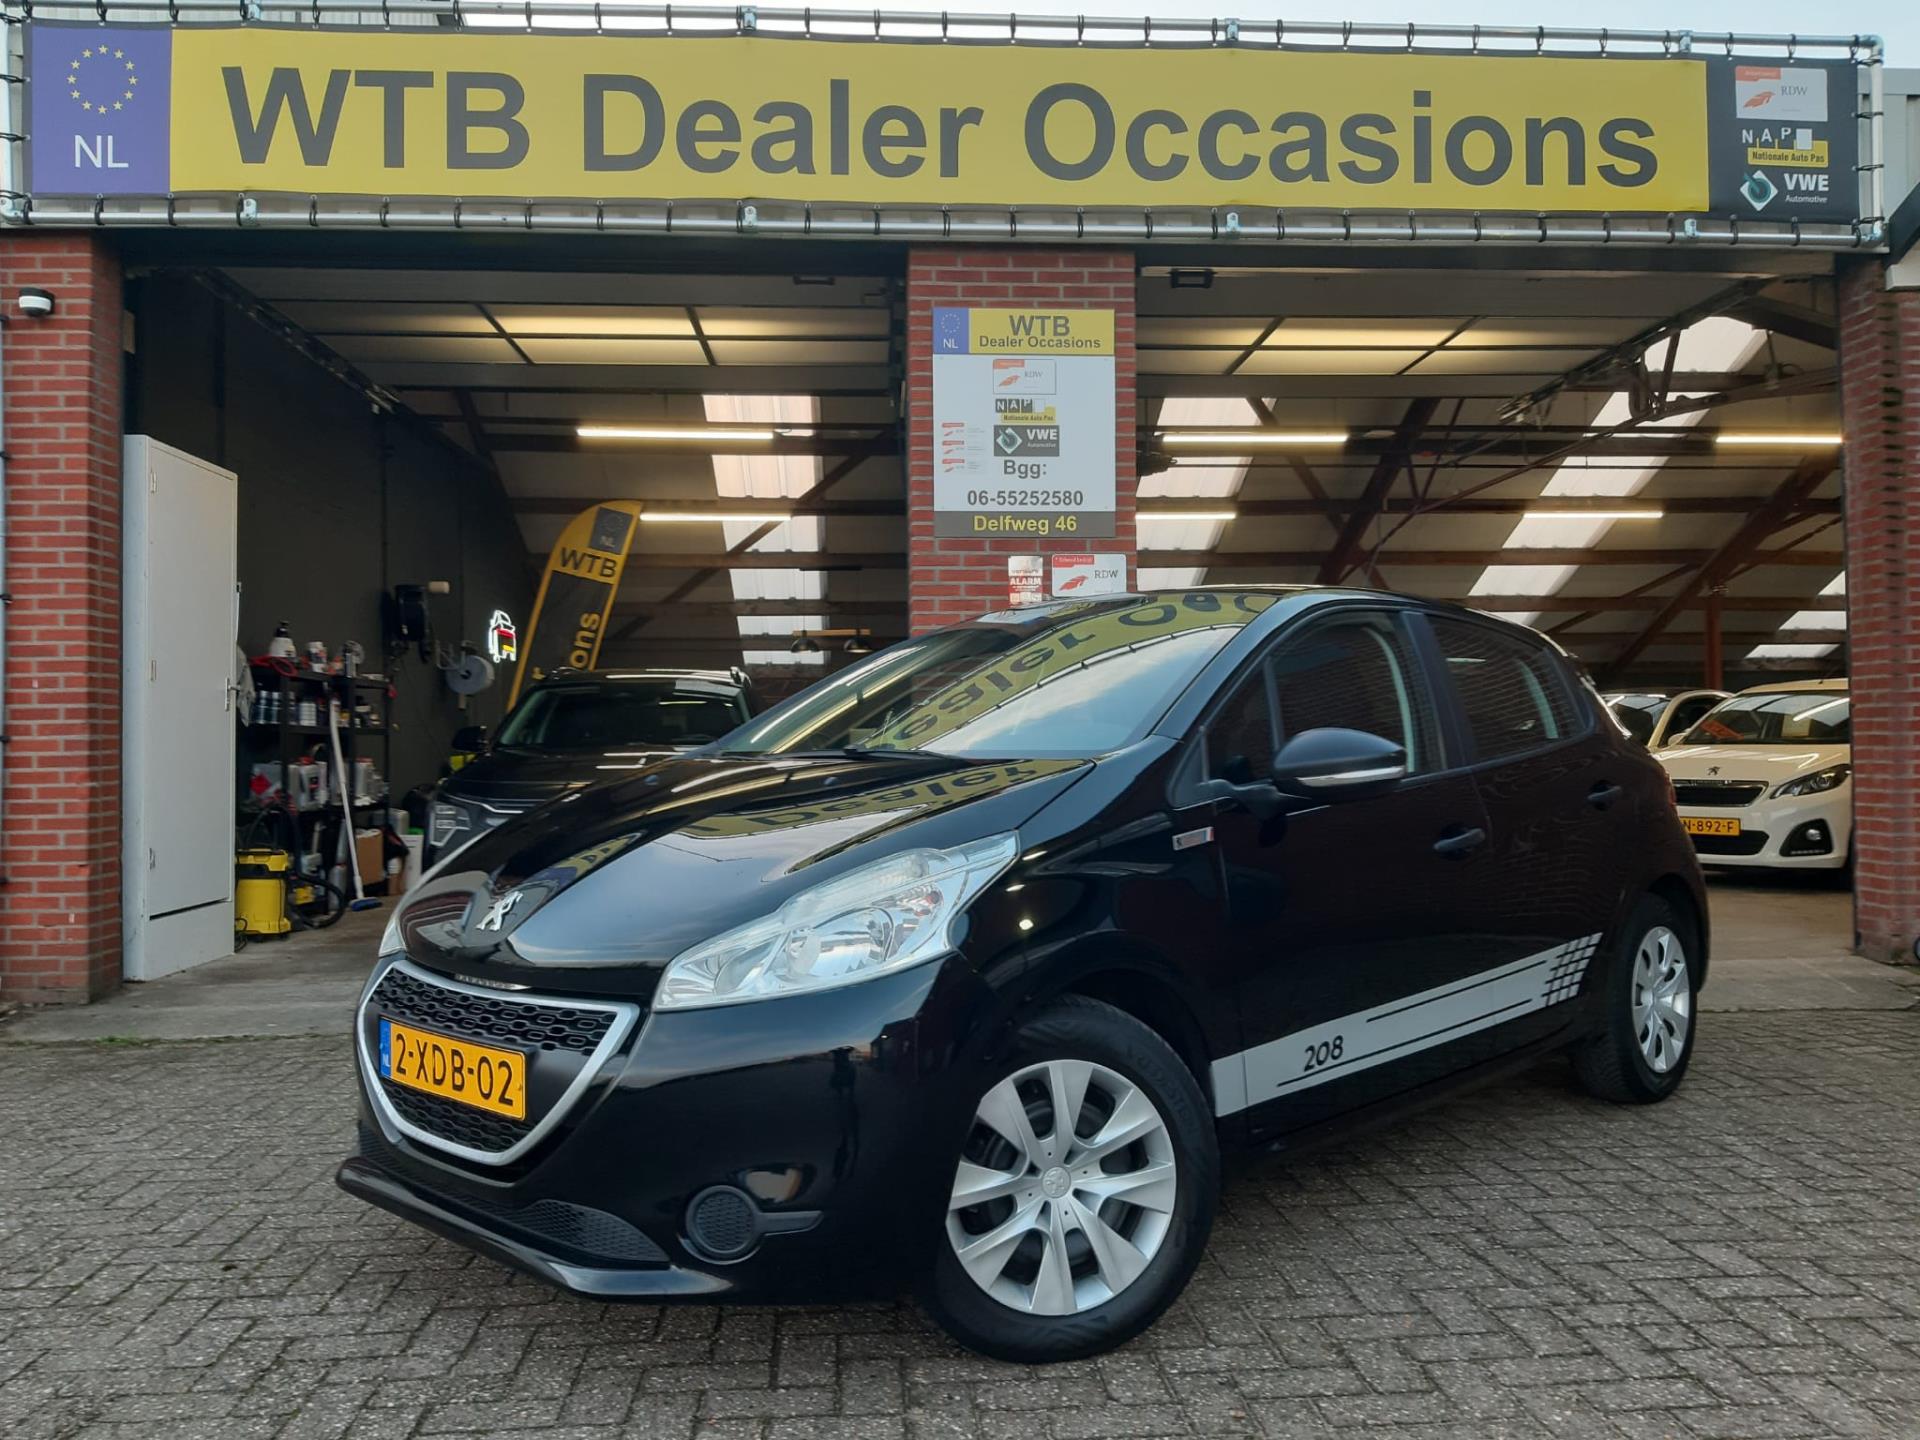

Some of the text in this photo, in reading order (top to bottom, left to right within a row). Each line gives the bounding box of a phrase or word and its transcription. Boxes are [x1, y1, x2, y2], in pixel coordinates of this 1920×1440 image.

[1781, 86, 1808, 97] RDW
[221, 66, 1658, 187] WTB Dealer Occasions
[74, 135, 129, 169] NL
[1752, 151, 1825, 164] Nationale Auto Pas
[1784, 173, 1829, 192] VWE
[1785, 195, 1828, 204] Automotive
[1009, 315, 1070, 337] WTB
[943, 338, 959, 349] NL
[979, 335, 1101, 348] Dealer Occasions
[1026, 428, 1058, 441] VWE
[1003, 459, 1048, 479] Bgg:
[967, 490, 1084, 506] 06-55252580
[974, 515, 1078, 535] Delfweg 46
[560, 547, 617, 578] WTB
[1010, 577, 1041, 586] ALARM
[1094, 569, 1119, 579] RDW
[1303, 1035, 1344, 1072] 208
[395, 1033, 514, 1107] 2-XDB-02
